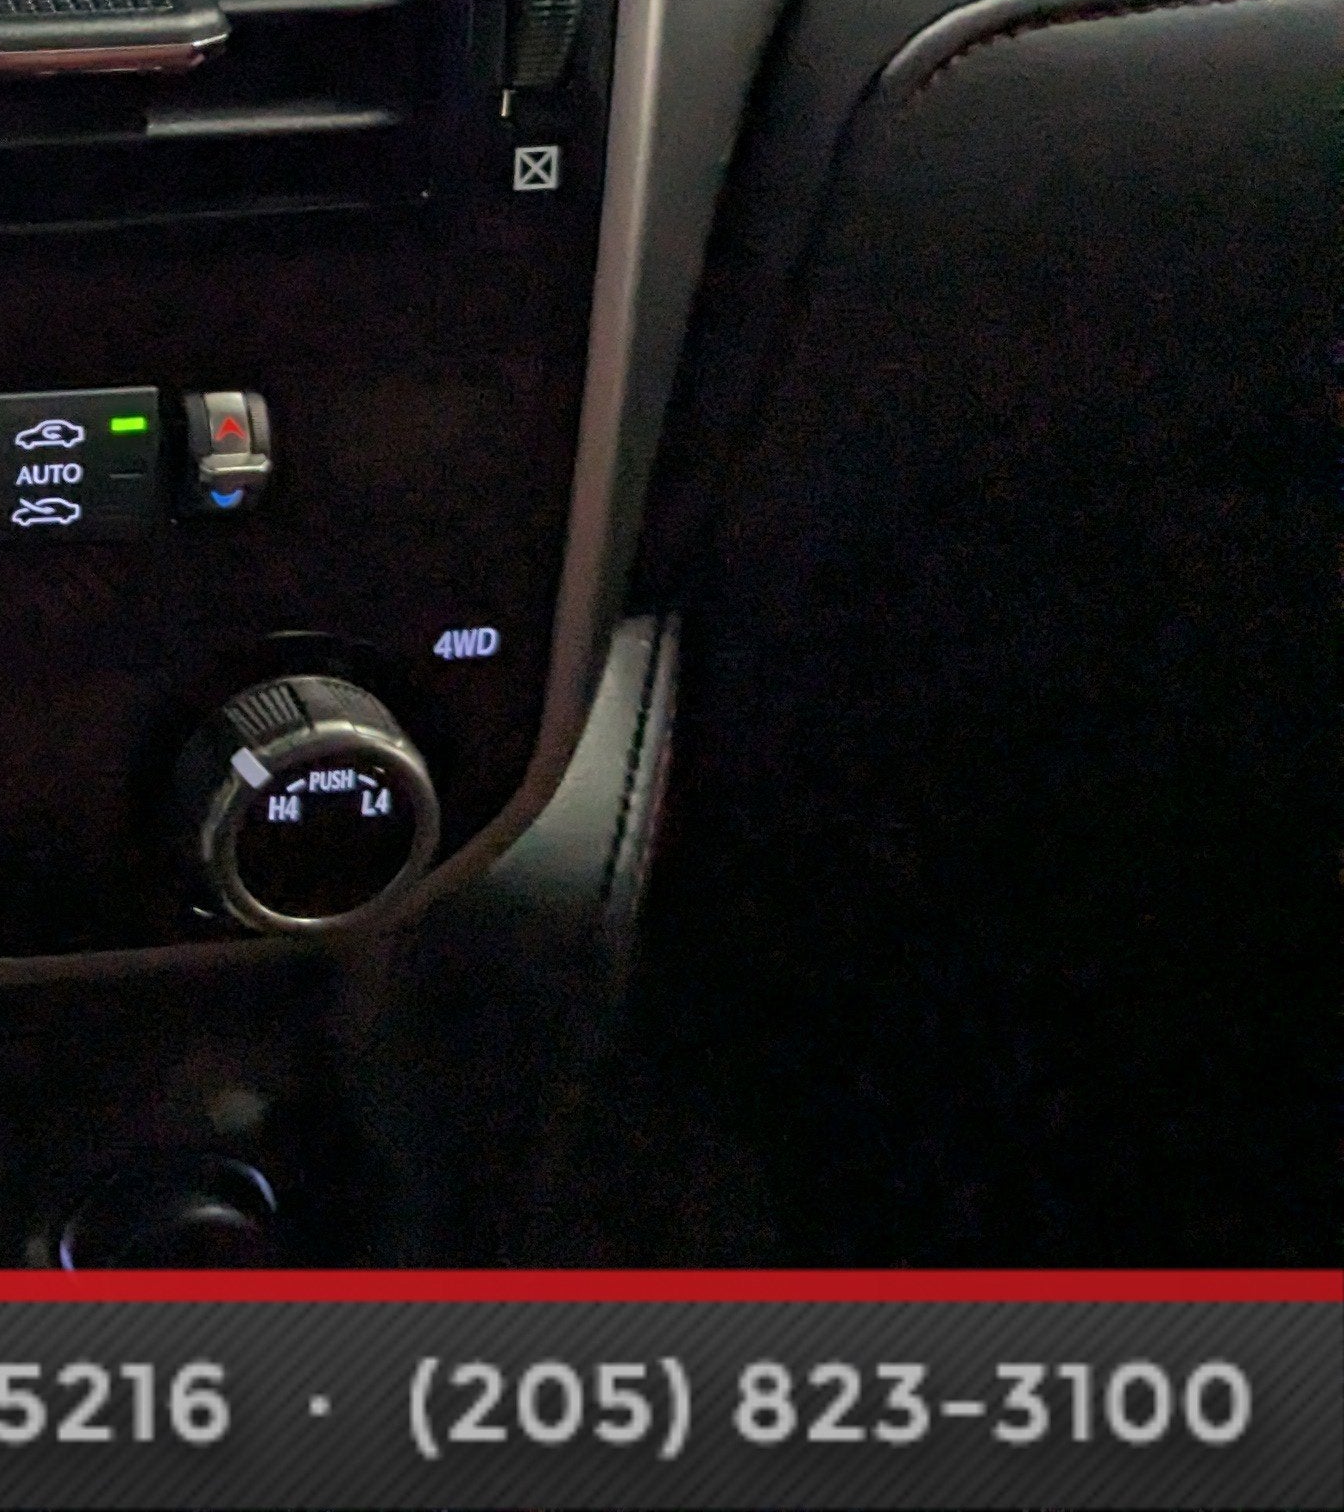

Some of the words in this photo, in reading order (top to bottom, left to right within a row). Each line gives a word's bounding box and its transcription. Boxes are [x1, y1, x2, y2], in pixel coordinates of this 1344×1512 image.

[15, 462, 83, 486] AUTO
[433, 626, 500, 660] 4WD
[309, 768, 354, 792] PUSH
[267, 795, 300, 822] H4
[361, 788, 390, 817] L4
